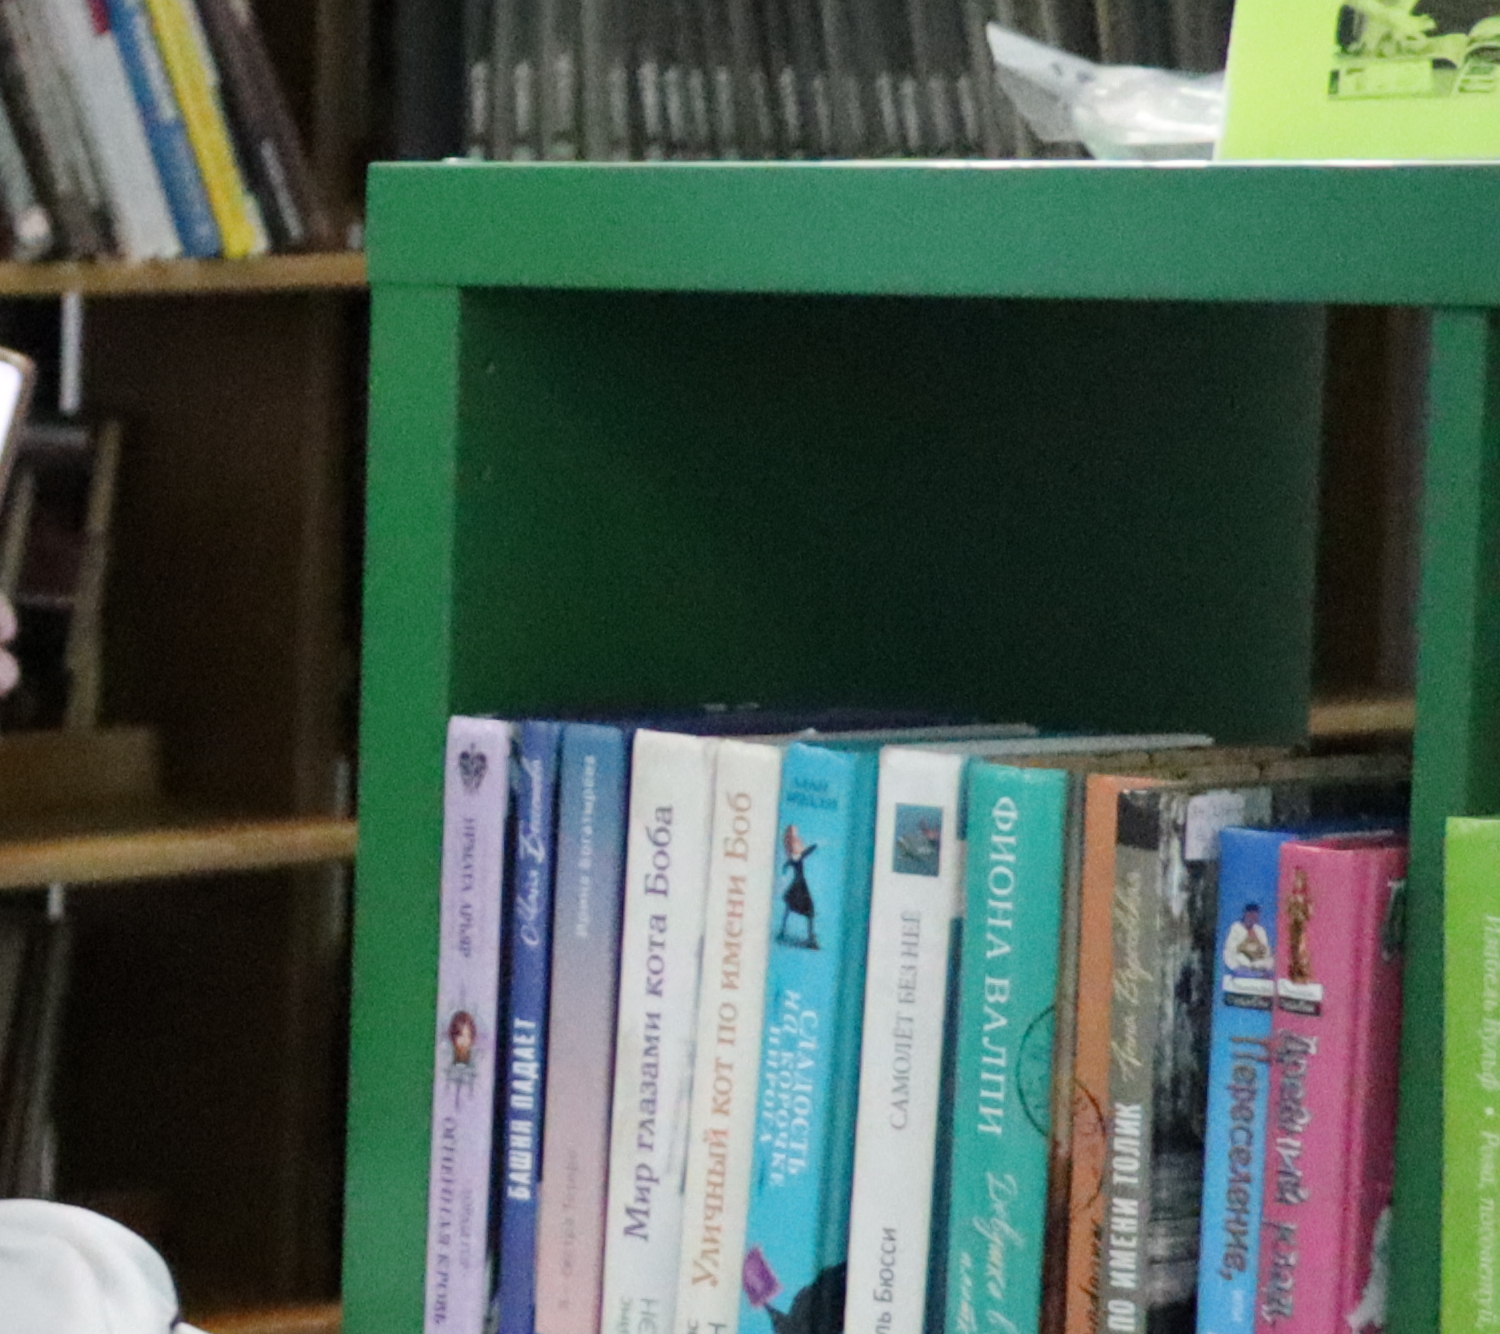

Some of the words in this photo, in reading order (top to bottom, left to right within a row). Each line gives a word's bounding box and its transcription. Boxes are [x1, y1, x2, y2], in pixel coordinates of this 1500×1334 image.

[643, 805, 674, 896] Боба
[722, 792, 753, 861] Боб
[983, 796, 1022, 959] ФИОНА
[644, 914, 670, 997] кота
[717, 875, 747, 991] имени
[714, 1003, 737, 1044] по
[893, 963, 917, 1006] БЕЗ
[512, 1018, 538, 1100] ПАДАЕТ
[636, 1012, 664, 1151] глазами
[707, 1056, 734, 1117] кот
[787, 1010, 818, 1174] СЛАДОСТЬ
[976, 975, 1012, 1135] ВАЛПИ
[508, 1114, 536, 1202] БАШНЯ
[770, 1052, 794, 1186] КОРОЧКЕ
[1112, 1102, 1141, 1185] ТОЛИК
[1219, 1033, 1268, 1283] Переселение,
[1275, 1030, 1316, 1204] Древний
[622, 1163, 658, 1242] Мир
[689, 1129, 729, 1288] Уличный
[973, 1172, 1023, 1299] Девушка
[1109, 1199, 1136, 1288] ИМЕНИ
[873, 1227, 898, 1302] Бюсси
[1107, 1299, 1134, 1331] ПО
